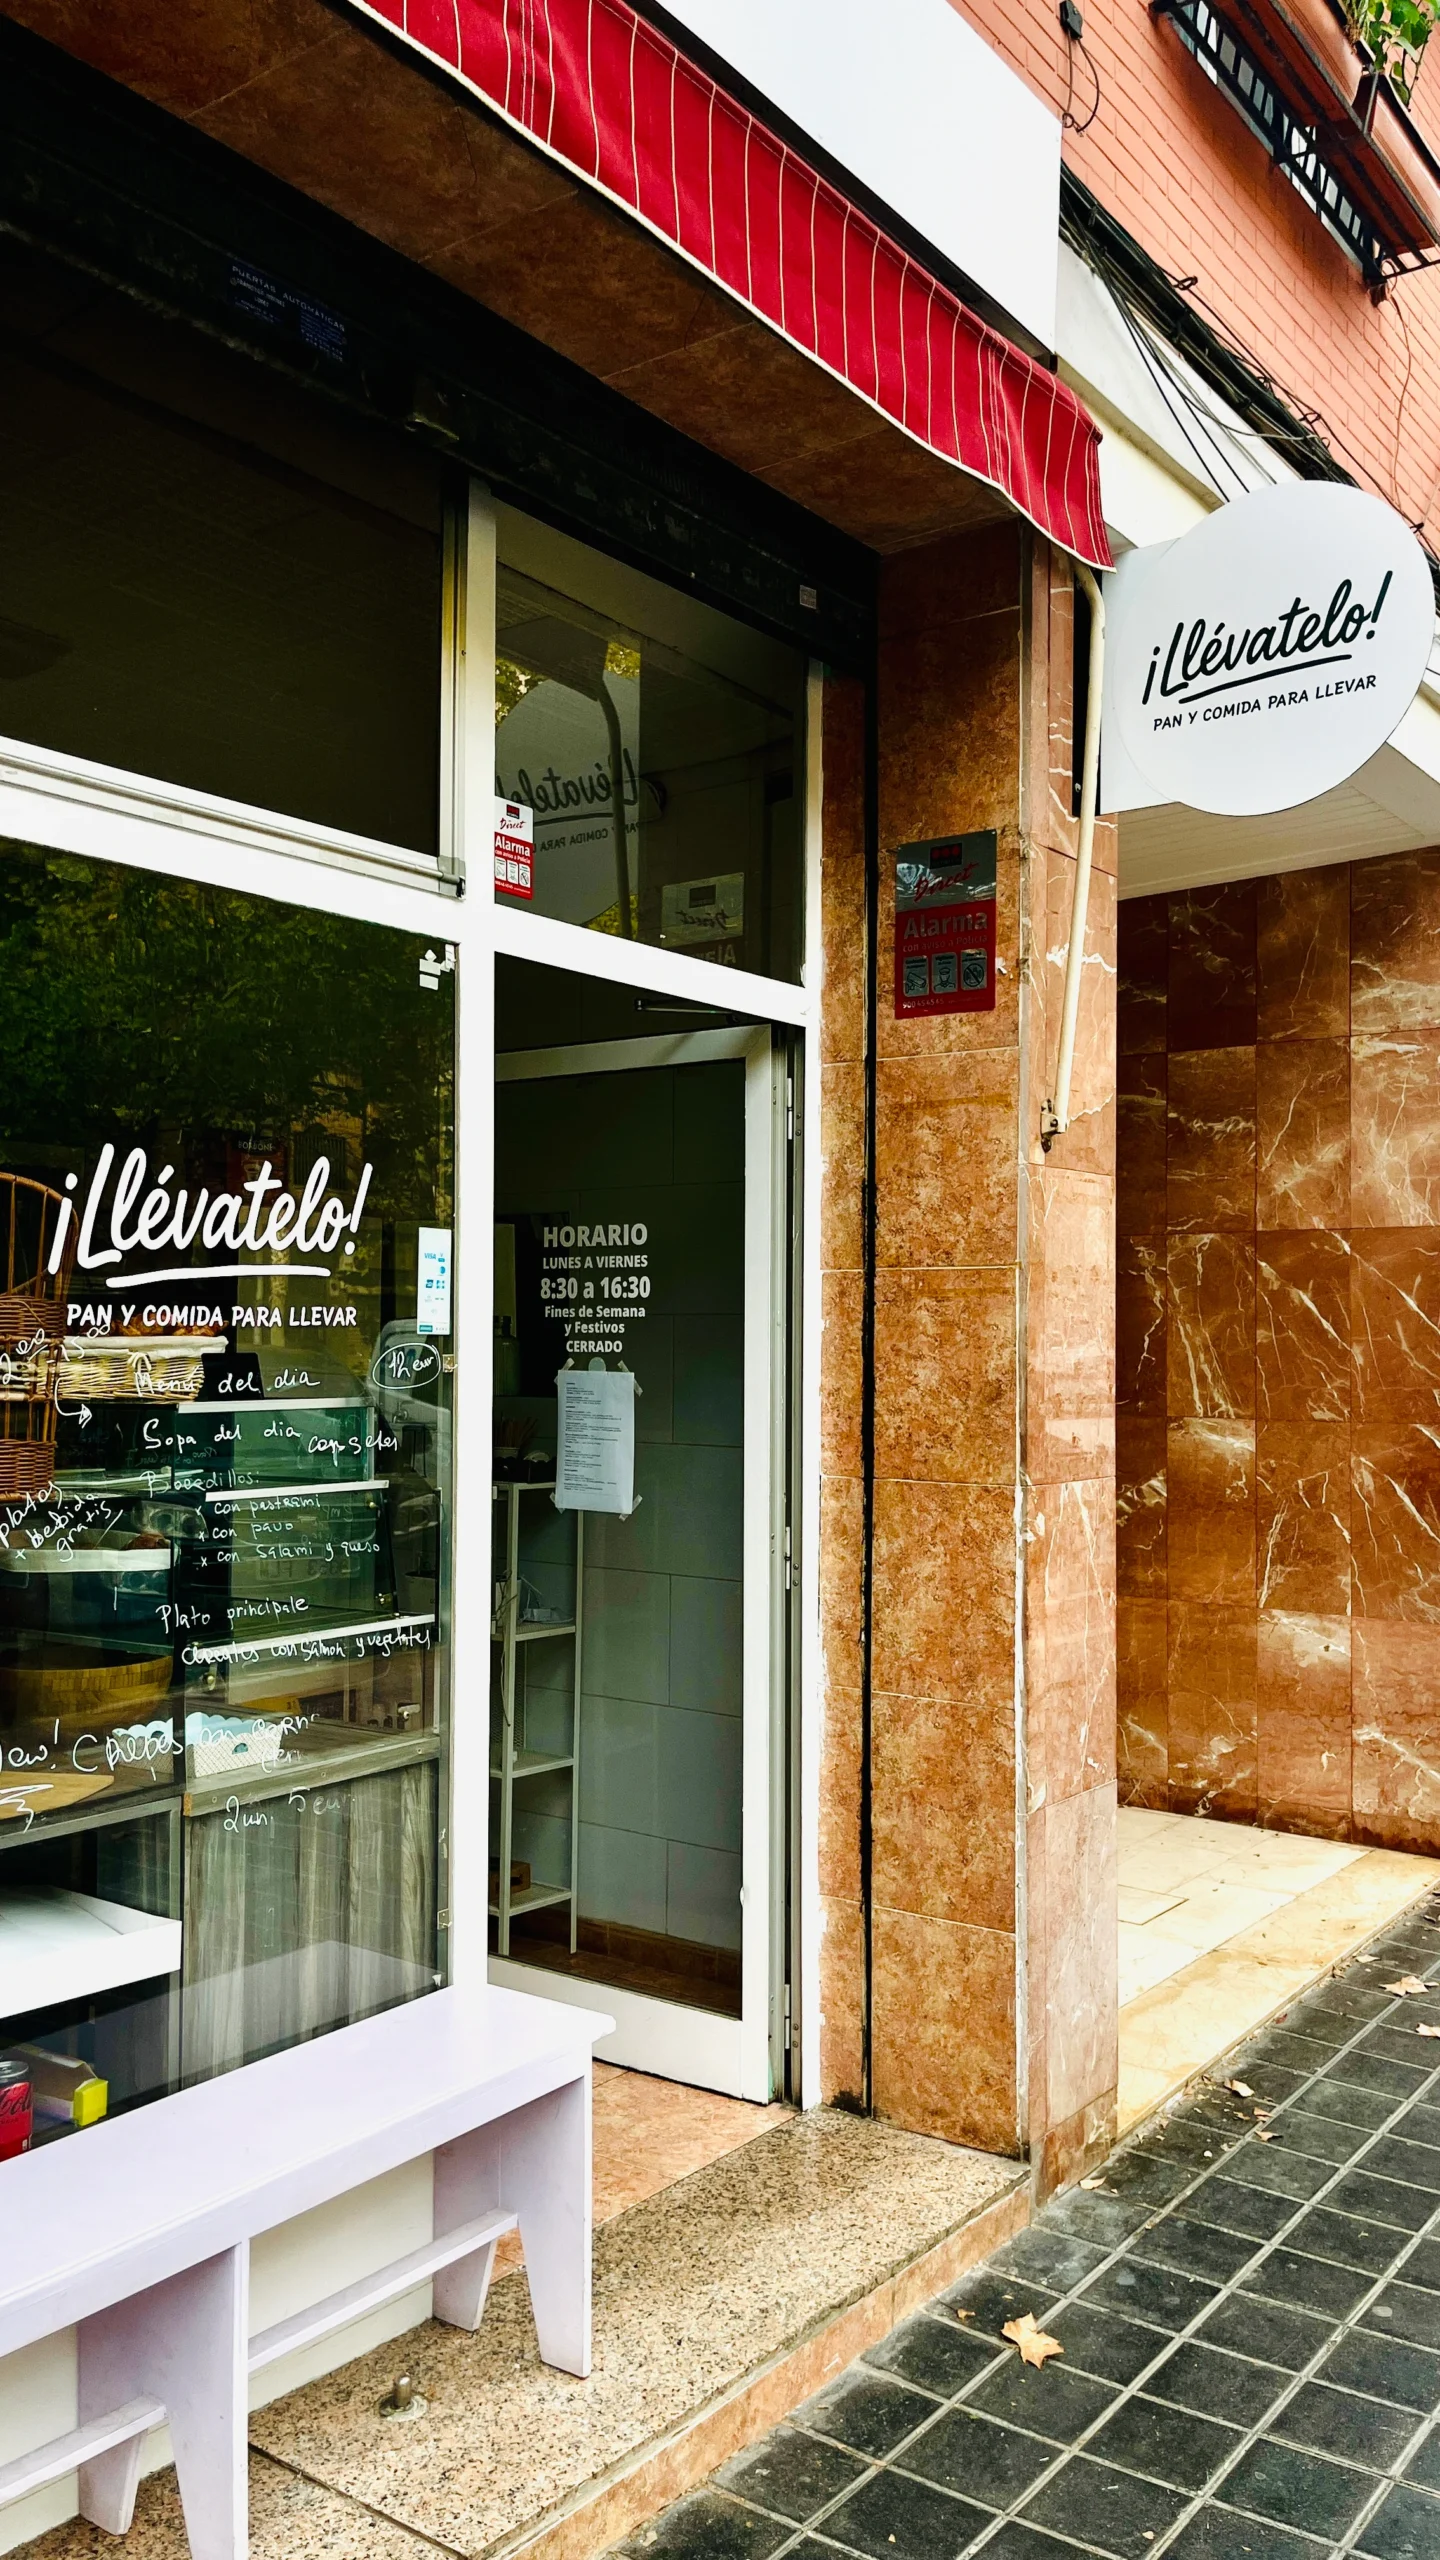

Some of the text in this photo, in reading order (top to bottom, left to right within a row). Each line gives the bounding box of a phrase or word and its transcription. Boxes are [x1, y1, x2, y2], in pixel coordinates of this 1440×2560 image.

[231, 265, 277, 293] PUERTAS
[1142, 570, 1393, 705] ¡Llévatelo!
[1153, 675, 1377, 731] PAN Y COMIDA PARA LLEVAR
[499, 817, 526, 830] Direct
[495, 836, 531, 857] Alarma
[914, 861, 979, 903] Direct
[904, 911, 988, 940] Alarma
[902, 943, 919, 953] con
[921, 940, 946, 950] aviso
[47, 1142, 374, 1275] ¡Llévatelo!
[543, 1223, 648, 1248] HORARIO
[542, 1254, 648, 1270] LUNES A VIERNES
[540, 1275, 651, 1299] 8:30 a 16:30
[66, 1304, 357, 1328] PAN Y COMIDA PARA LLEVAR
[544, 1305, 646, 1318] Fines de Semana
[564, 1320, 625, 1336] y Festivos
[565, 1339, 623, 1353] CERRADO
[217, 1371, 260, 1393] del
[142, 1418, 197, 1454] Sopa
[214, 1423, 242, 1442] del
[263, 1420, 301, 1439] dia
[214, 1502, 241, 1515] con
[212, 1522, 294, 1540] con pavo
[217, 1550, 241, 1563] con
[324, 1541, 334, 1562] y
[341, 1541, 380, 1557] queso
[155, 1604, 210, 1633] Plato
[0, 1719, 60, 1771] ew!
